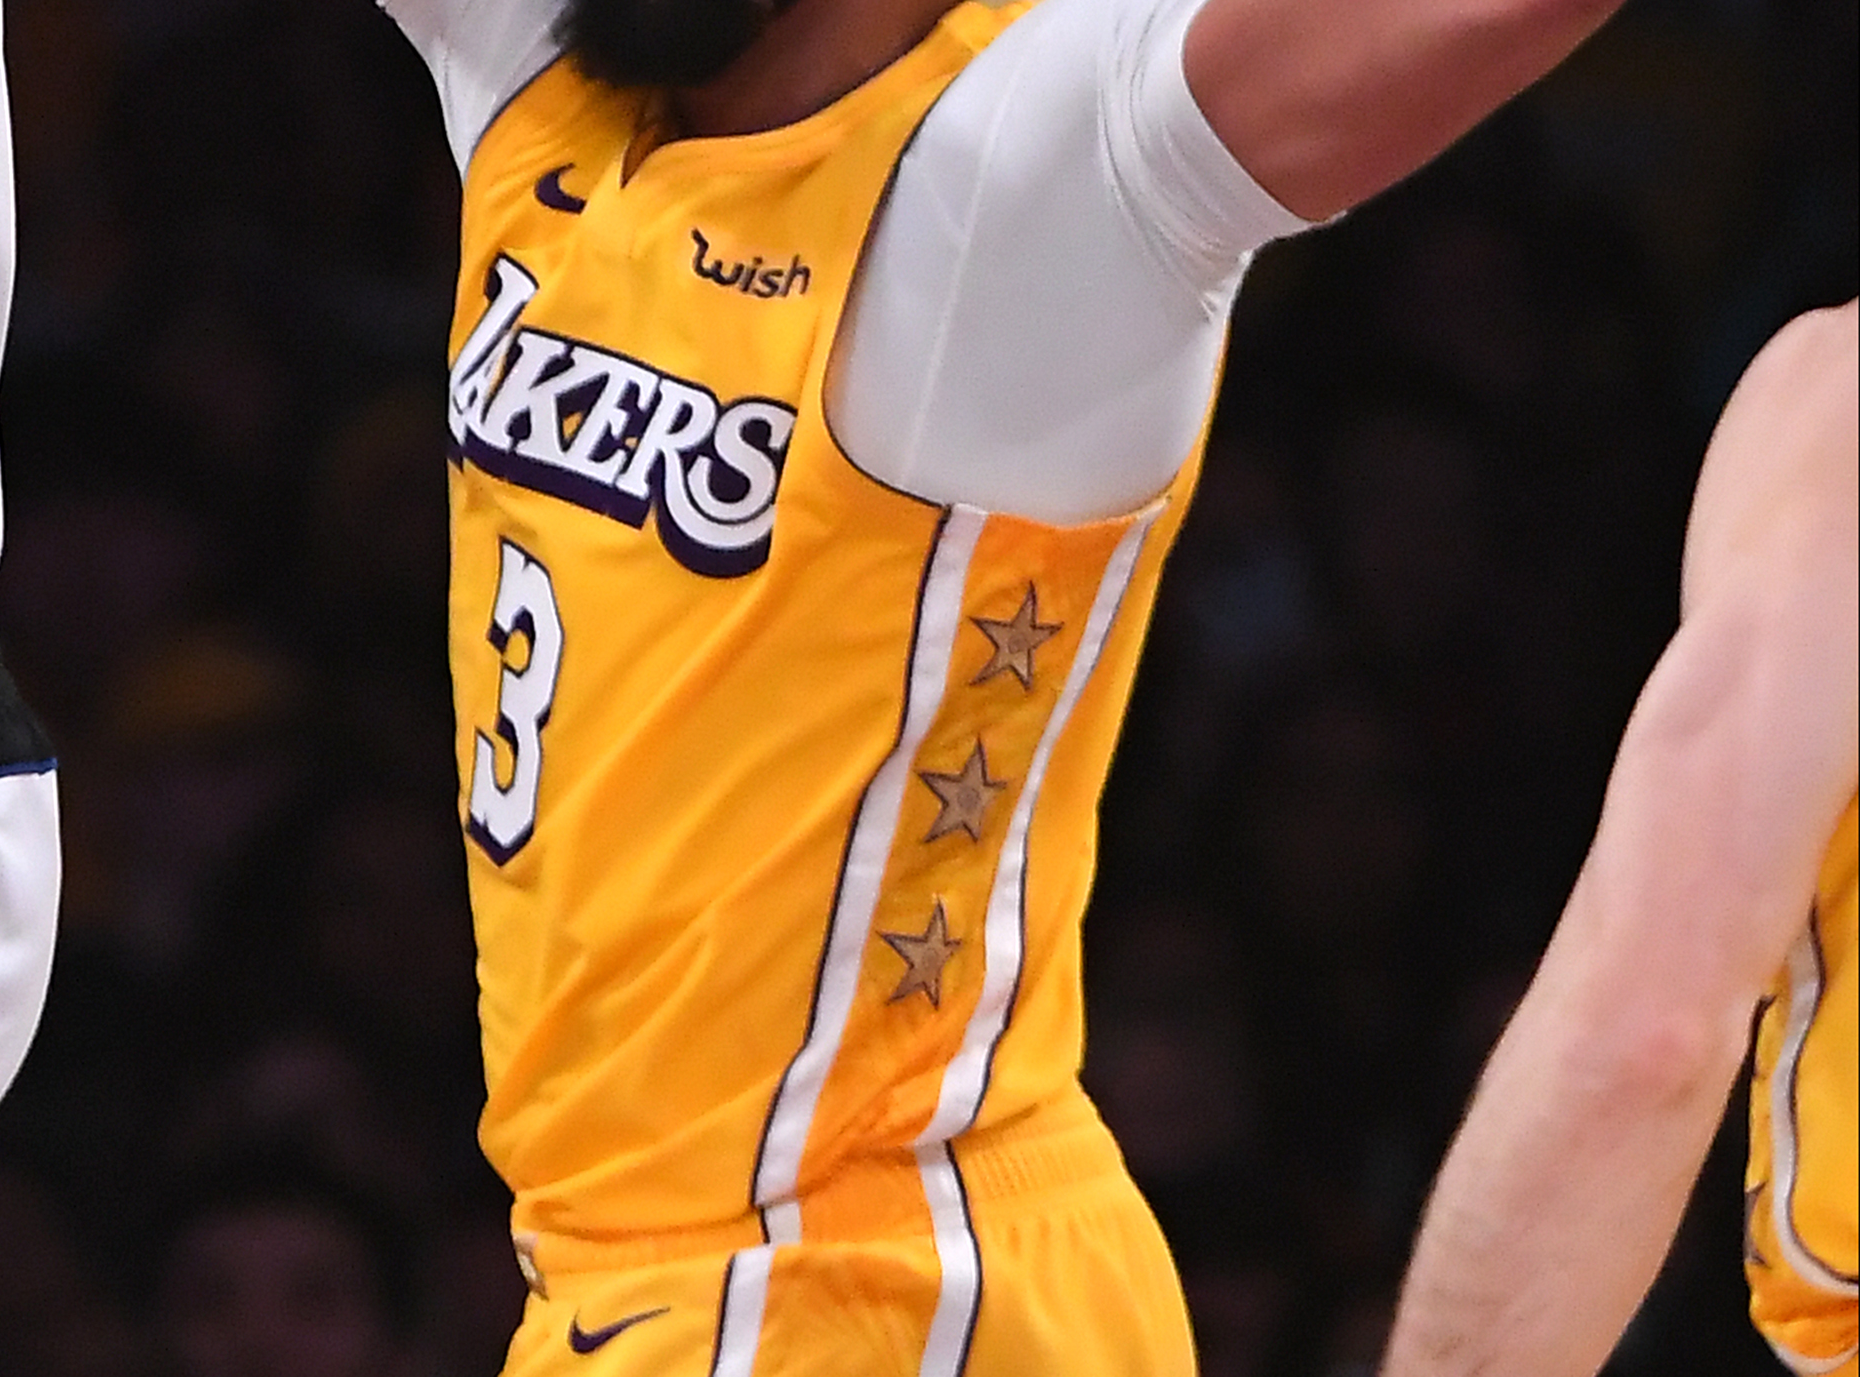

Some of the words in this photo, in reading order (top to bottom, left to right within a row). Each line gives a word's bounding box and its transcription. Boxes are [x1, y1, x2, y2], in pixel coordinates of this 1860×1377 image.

[448, 251, 799, 579] LAKERS
[690, 226, 811, 299] wish
[467, 534, 565, 868] 3
